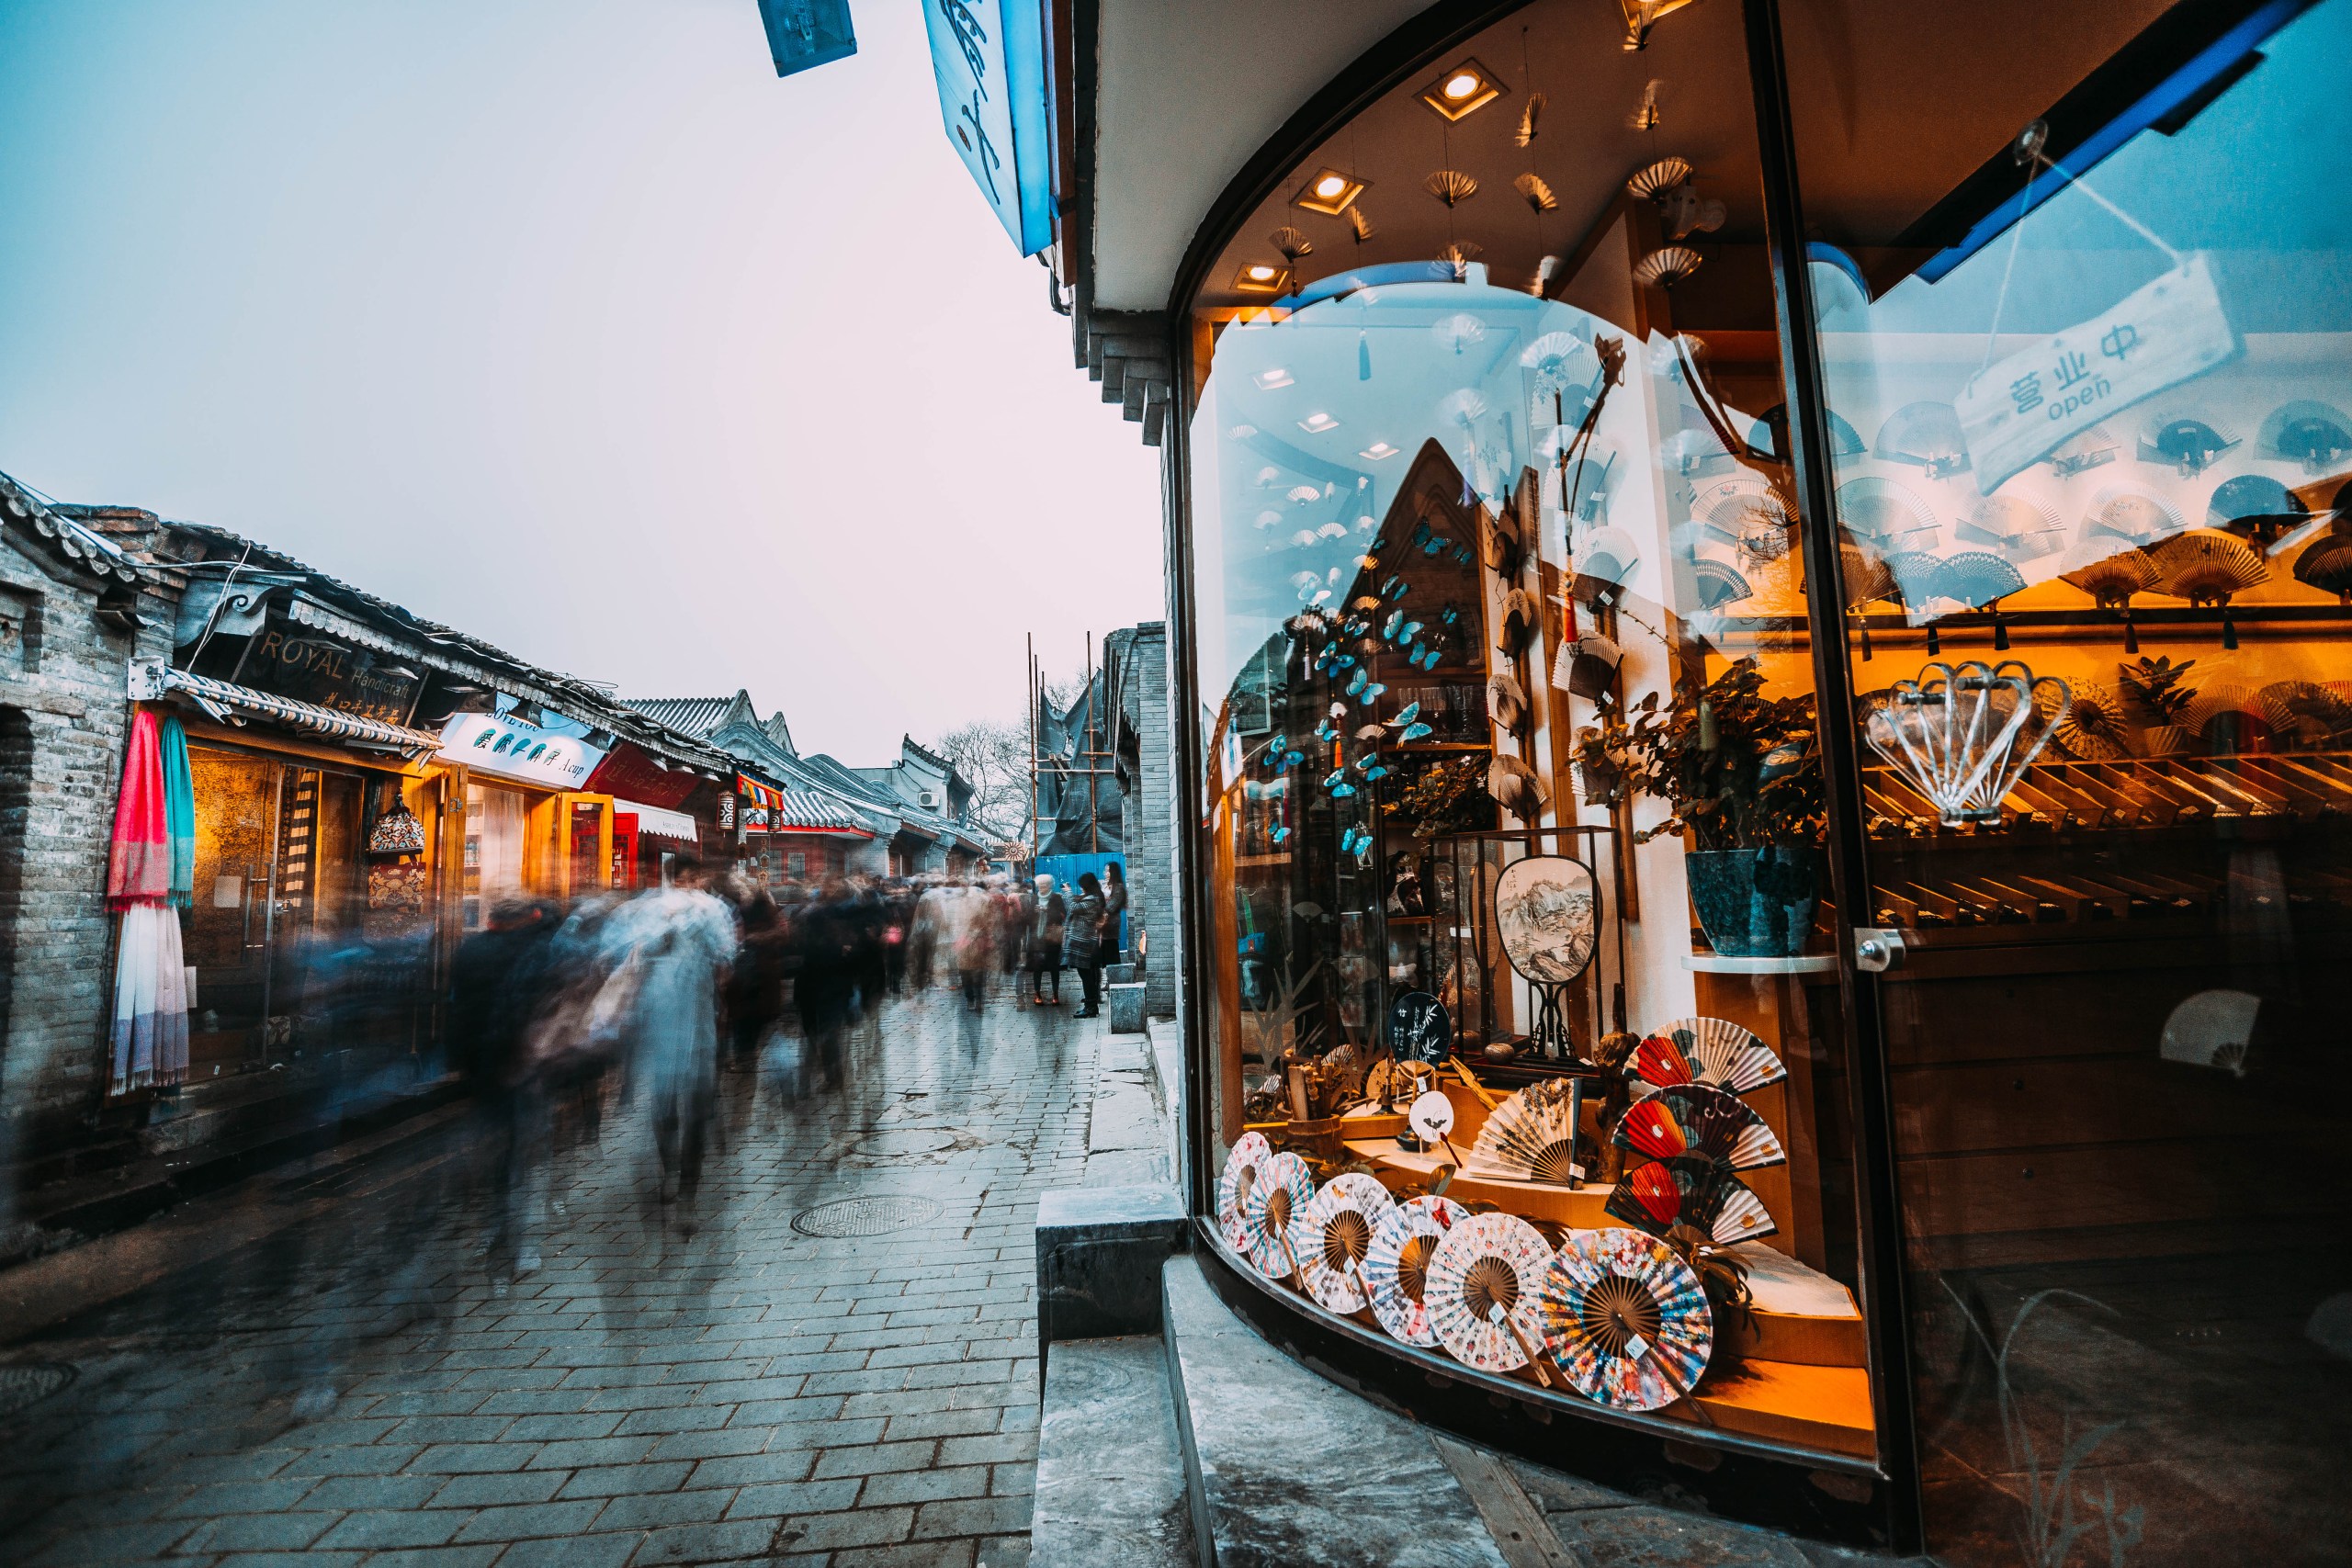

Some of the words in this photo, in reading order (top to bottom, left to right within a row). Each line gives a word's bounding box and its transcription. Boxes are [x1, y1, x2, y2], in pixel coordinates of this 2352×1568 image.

[2009, 324, 2137, 414] 营业中
[2048, 378, 2111, 421] open
[260, 631, 343, 680] ROYAL
[351, 668, 410, 699] Handicraft
[477, 733, 560, 766] 爱你一杯子
[568, 764, 584, 779] cup
